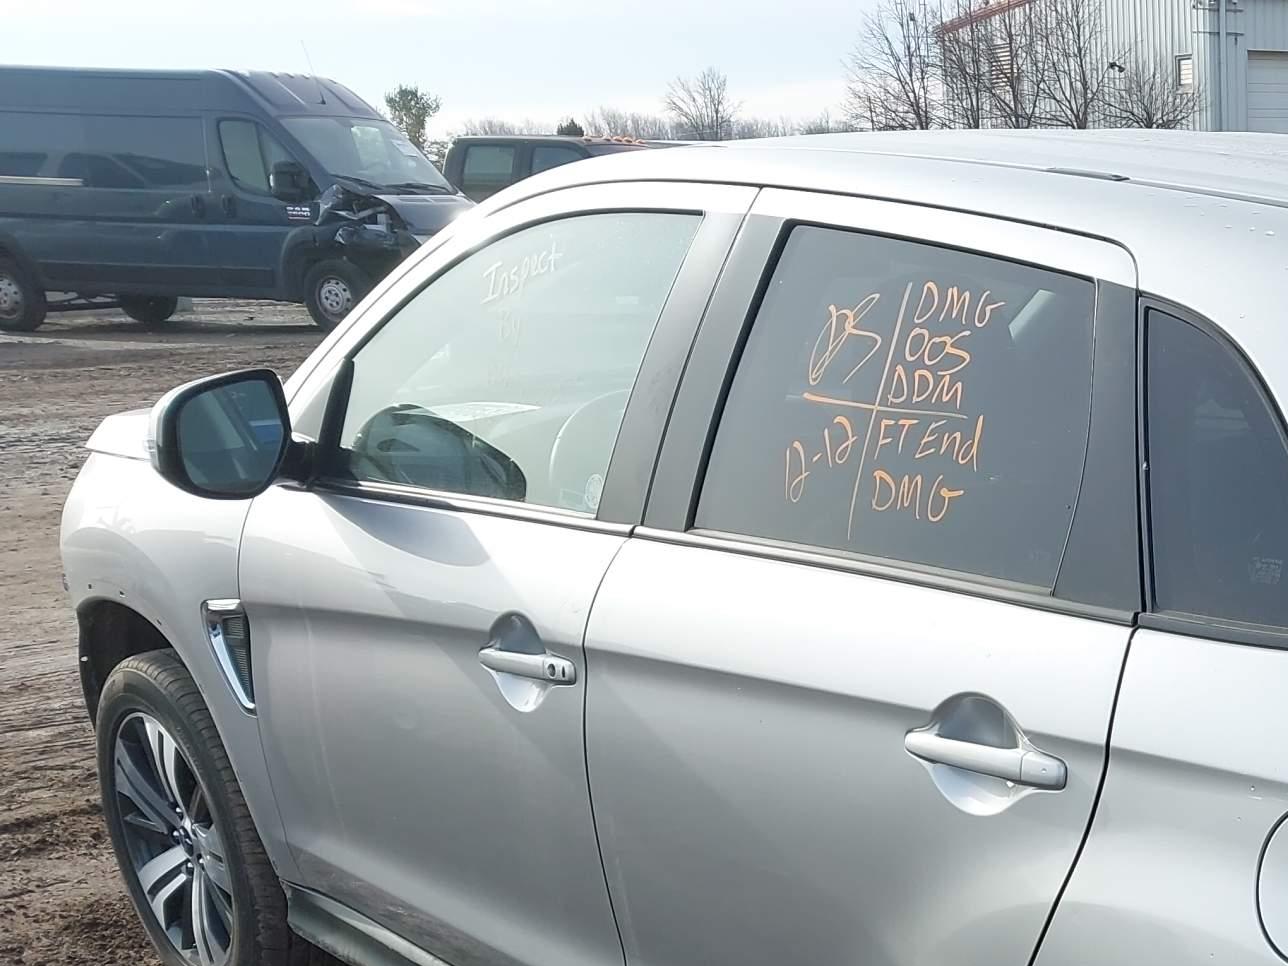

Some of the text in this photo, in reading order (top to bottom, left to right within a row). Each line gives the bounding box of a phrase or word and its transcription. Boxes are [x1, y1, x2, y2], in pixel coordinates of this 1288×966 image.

[480, 241, 562, 304] Inspect
[914, 281, 1005, 327] DMG
[874, 414, 985, 472] FT End
[871, 469, 964, 522] DMG
